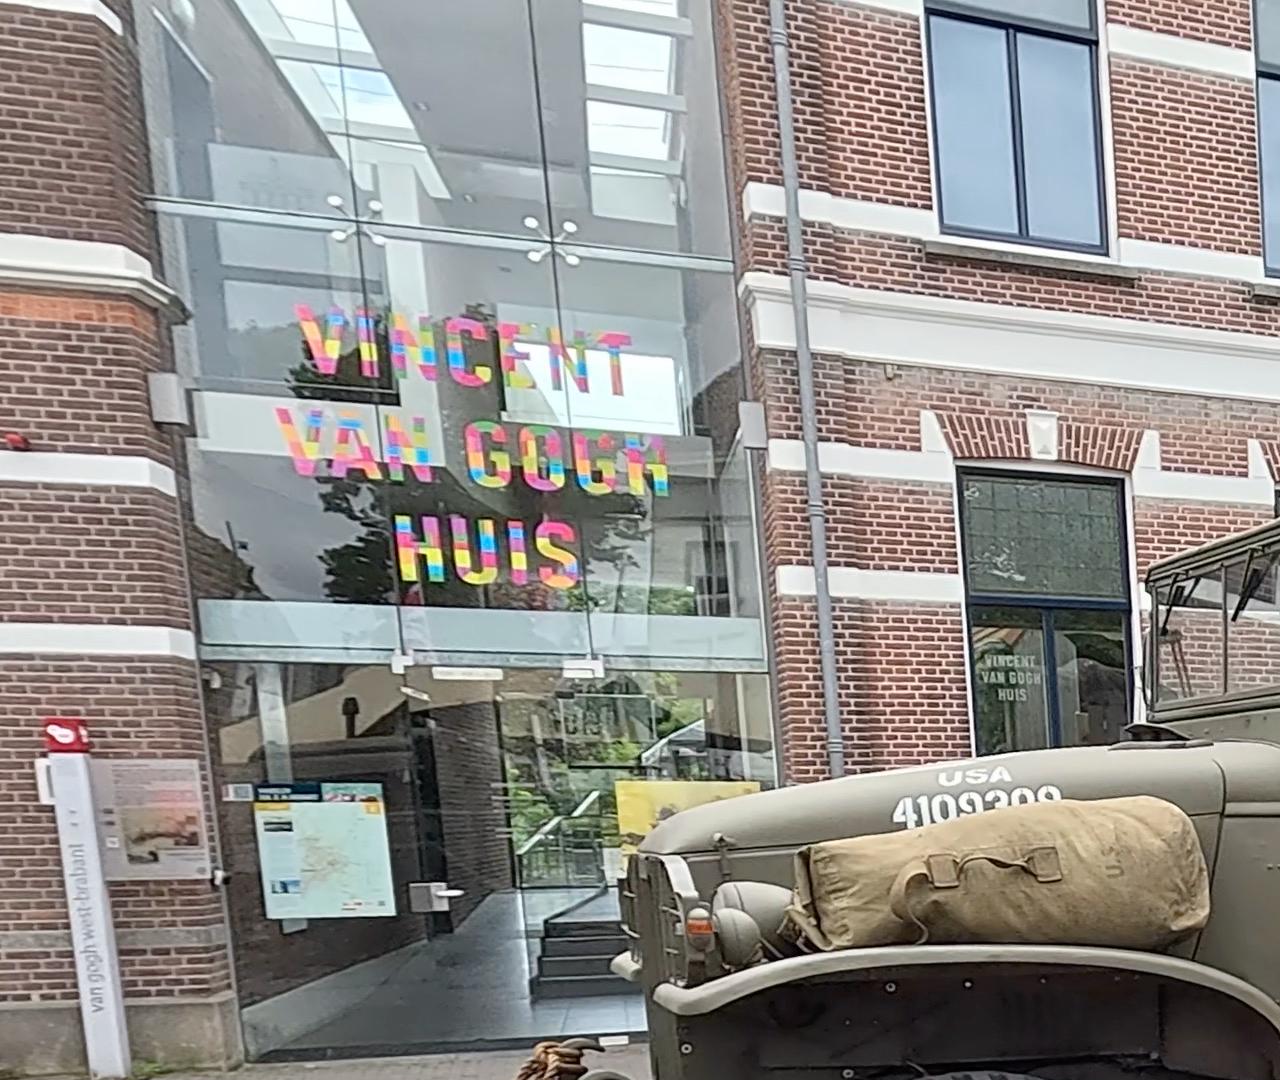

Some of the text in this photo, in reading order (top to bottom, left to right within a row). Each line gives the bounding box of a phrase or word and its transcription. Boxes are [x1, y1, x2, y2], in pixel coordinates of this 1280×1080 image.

[293, 303, 633, 397] VINCENT
[274, 406, 671, 498] VAN GOGH
[393, 514, 582, 590] HUIS
[981, 671, 1006, 683] VAN
[997, 688, 1028, 702] HUIS
[937, 765, 1013, 787] USA
